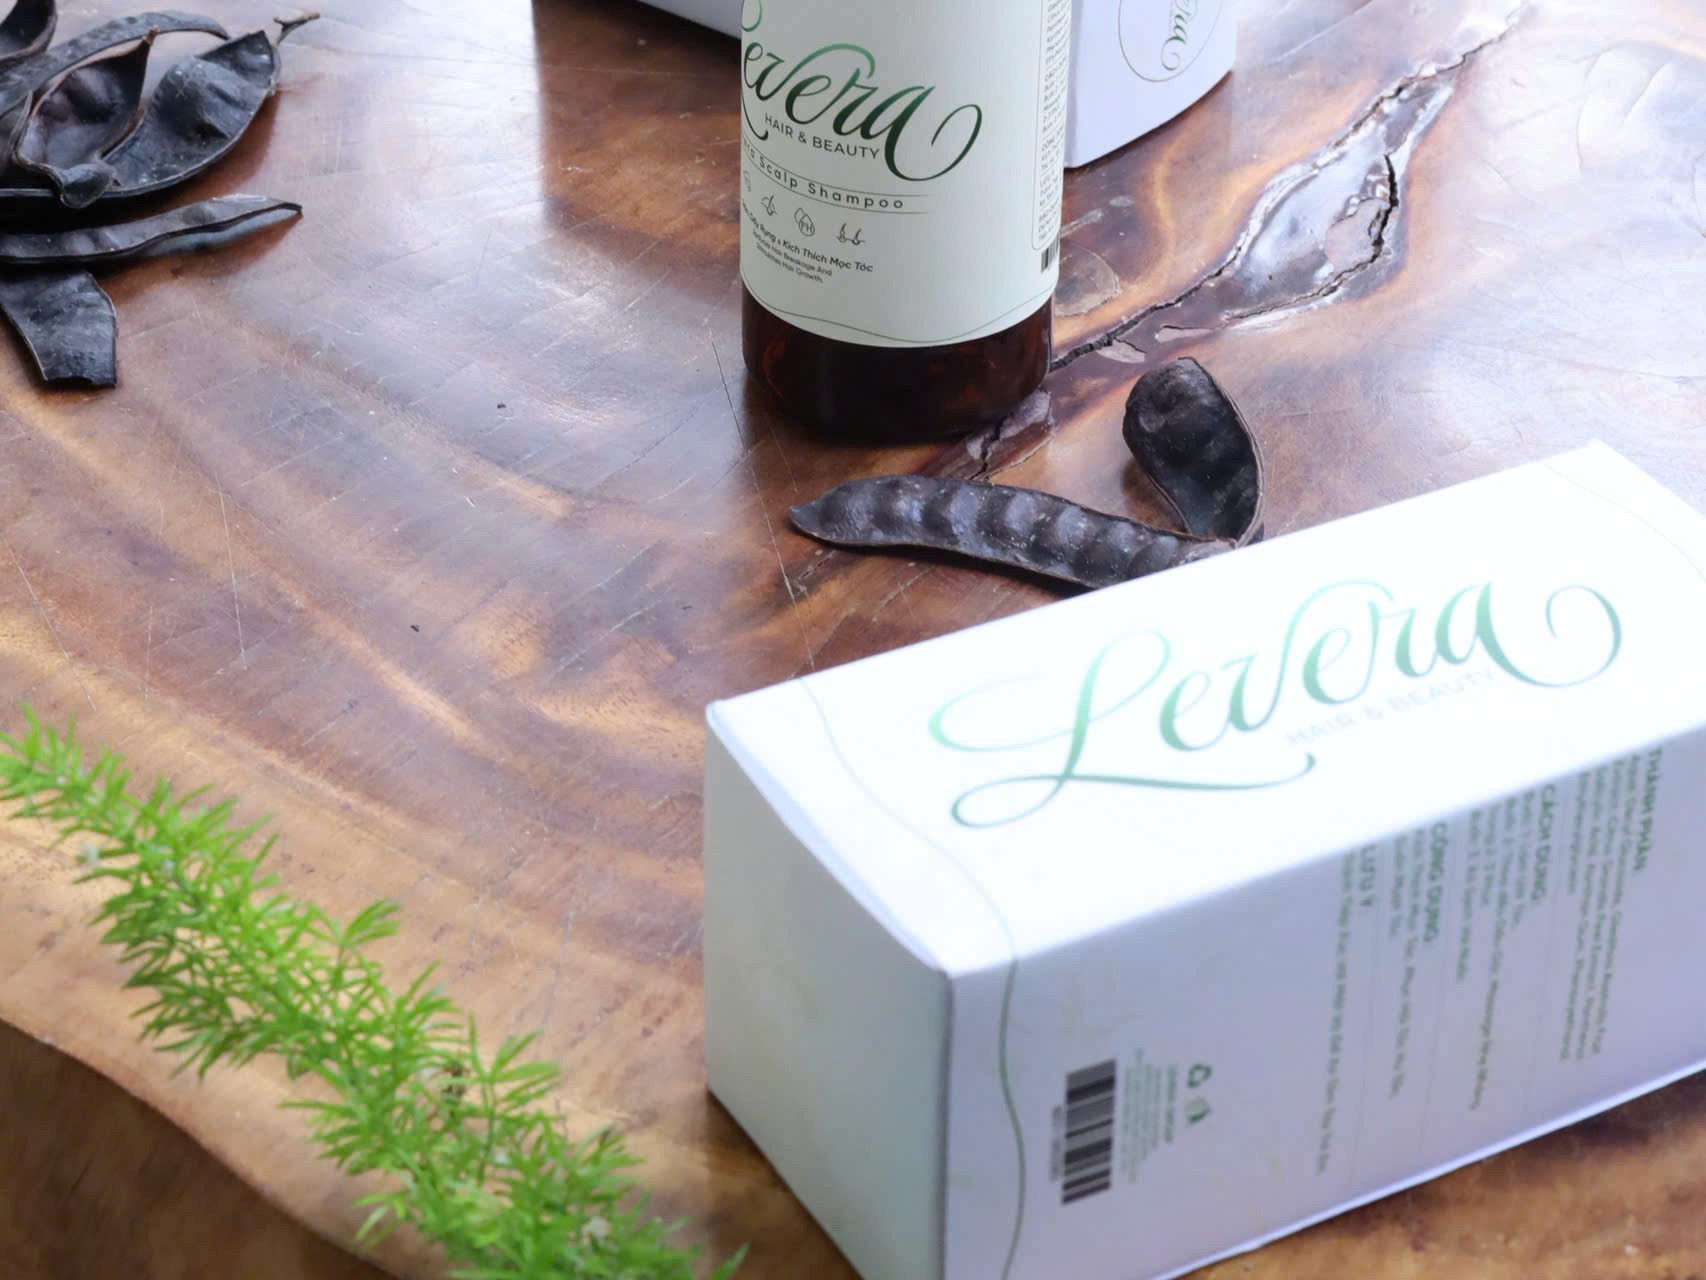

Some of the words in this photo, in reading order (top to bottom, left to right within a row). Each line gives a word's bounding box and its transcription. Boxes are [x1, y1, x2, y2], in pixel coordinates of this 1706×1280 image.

[764, 112, 793, 139] HAIR
[798, 131, 808, 145] &
[812, 135, 880, 160] BEAUTY
[758, 154, 798, 189] Scalp
[807, 181, 905, 210] Shampoo
[829, 256, 851, 272] Mọc
[855, 262, 873, 273] Tóc
[927, 578, 1623, 829] Levera
